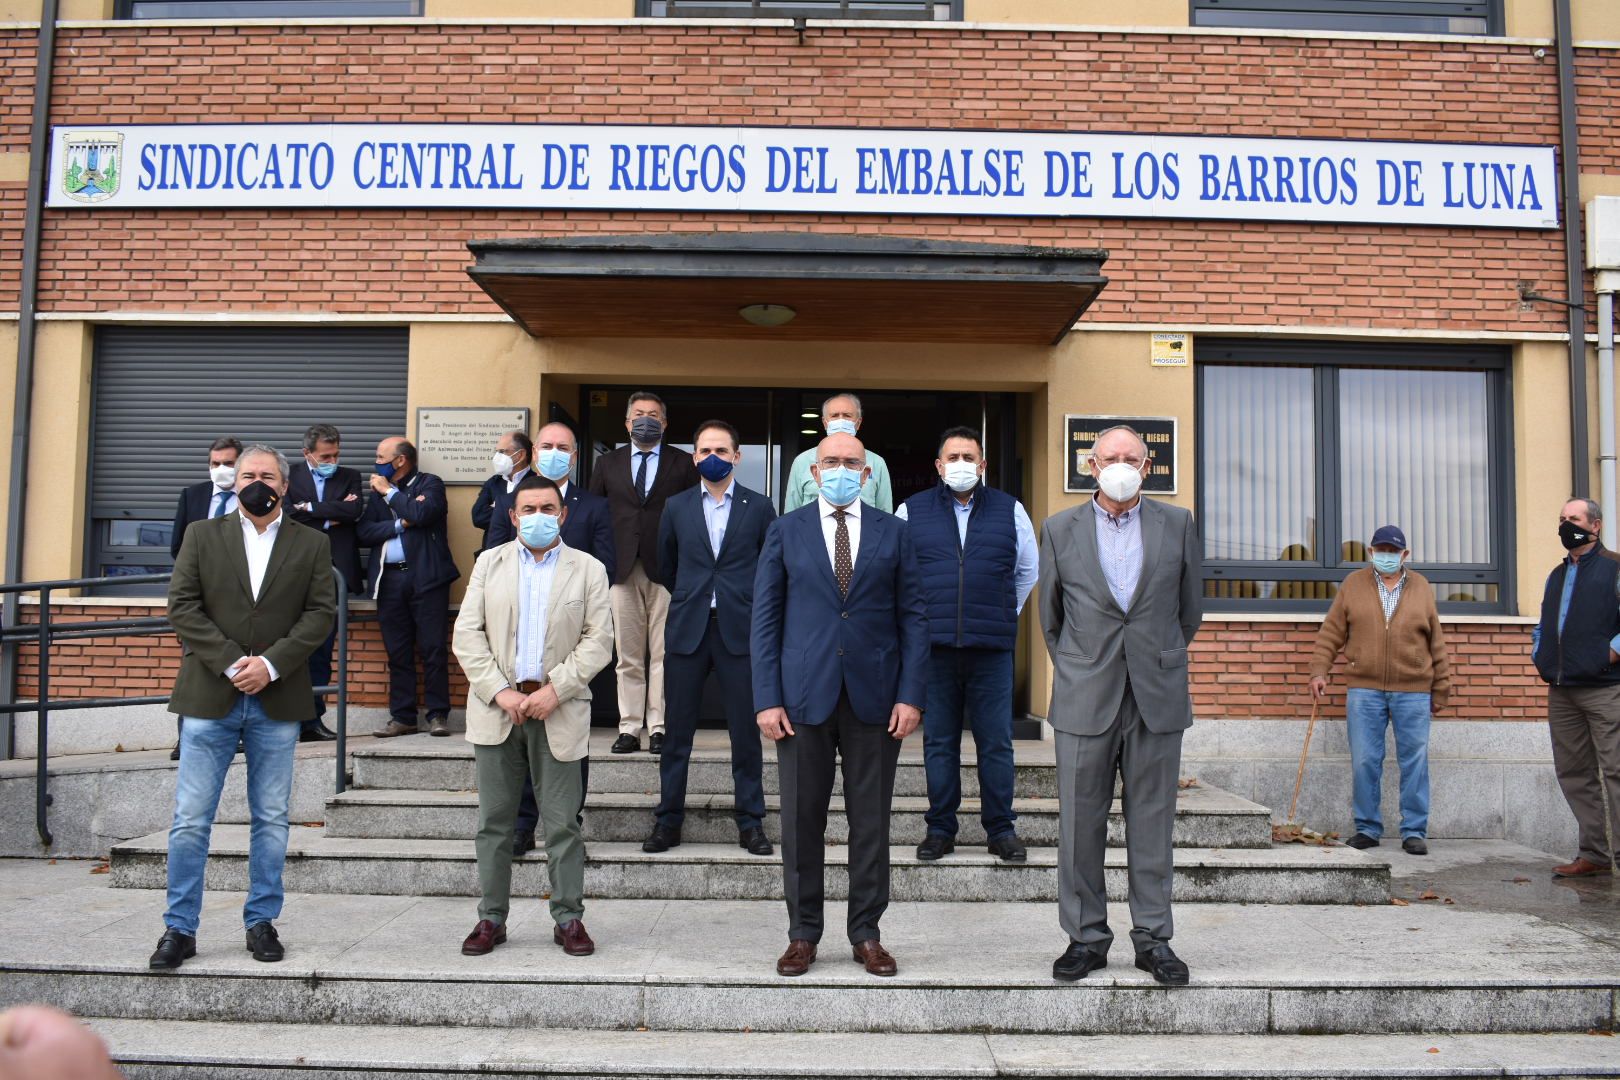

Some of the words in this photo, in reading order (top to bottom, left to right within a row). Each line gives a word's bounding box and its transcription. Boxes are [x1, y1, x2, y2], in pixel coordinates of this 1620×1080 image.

[138, 142, 335, 191] SINDICATO
[353, 142, 523, 190] CENTRAL
[540, 143, 590, 191] DE
[608, 143, 746, 193] RIEGOS
[764, 146, 838, 194] DEL
[855, 147, 1025, 198] EMBALSE
[1043, 150, 1093, 198] DE
[1111, 151, 1180, 201] LOS
[1199, 154, 1358, 206] BARRIOS
[1375, 159, 1425, 207] DE
[1441, 161, 1543, 211] LUNA
[1073, 431, 1100, 441] SINDICA
[1146, 433, 1170, 443] RIEGOS
[1153, 465, 1170, 475] LUNA
